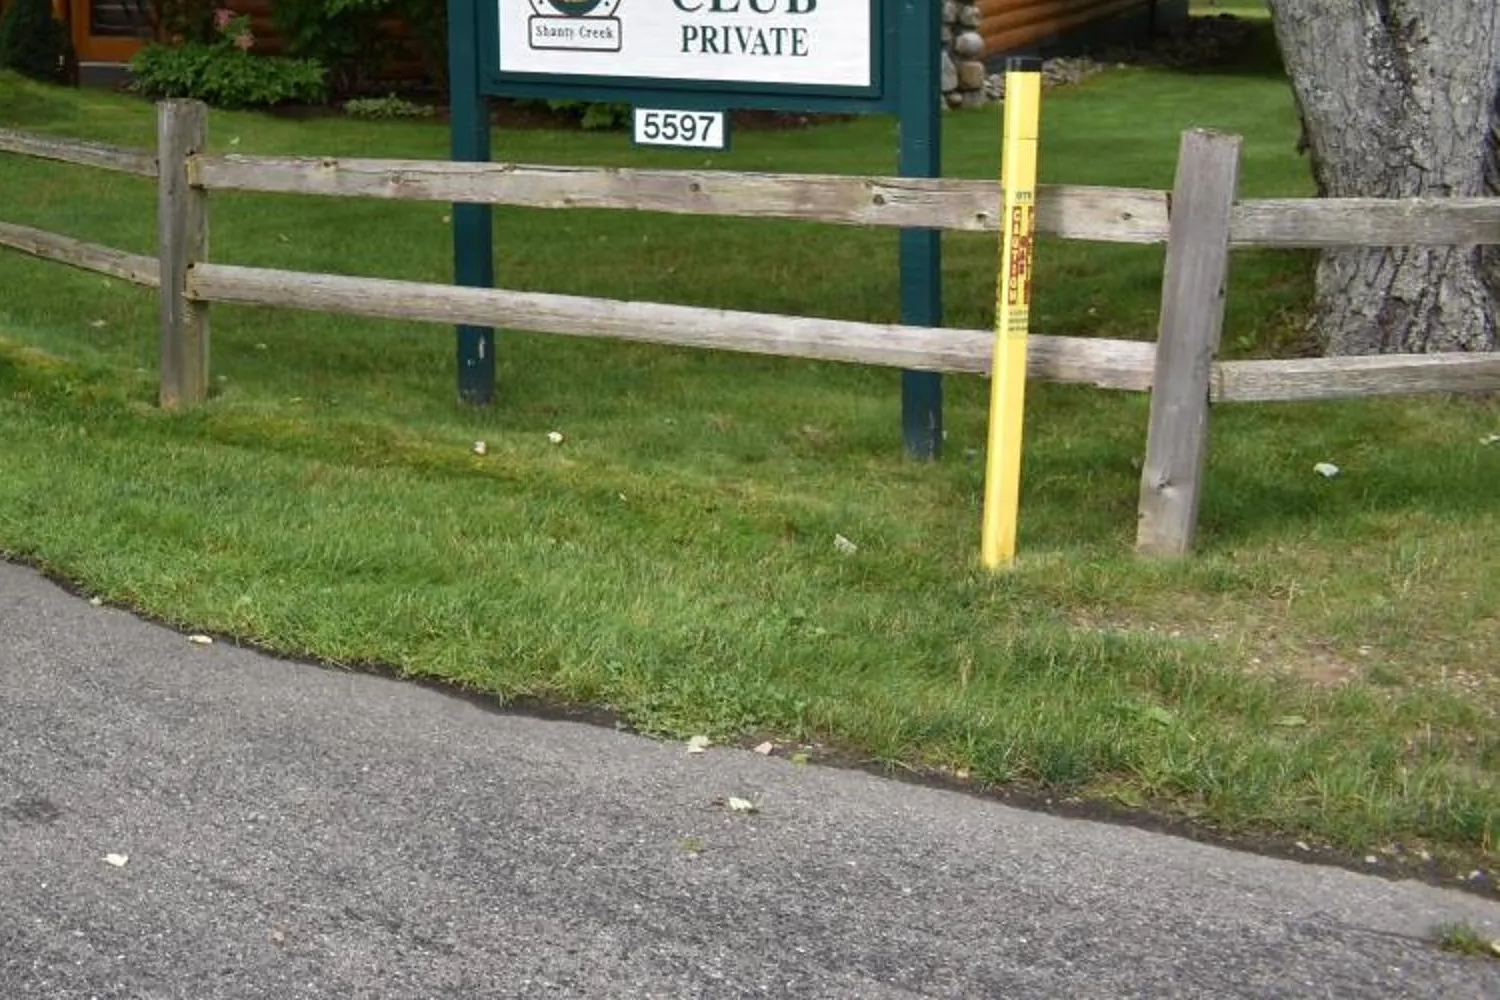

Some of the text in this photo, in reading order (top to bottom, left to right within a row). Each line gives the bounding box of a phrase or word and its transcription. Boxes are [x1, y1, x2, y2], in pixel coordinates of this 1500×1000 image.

[535, 25, 613, 40] Shanty Creek
[680, 24, 809, 57] PRIVATE
[643, 113, 715, 142] 5597
